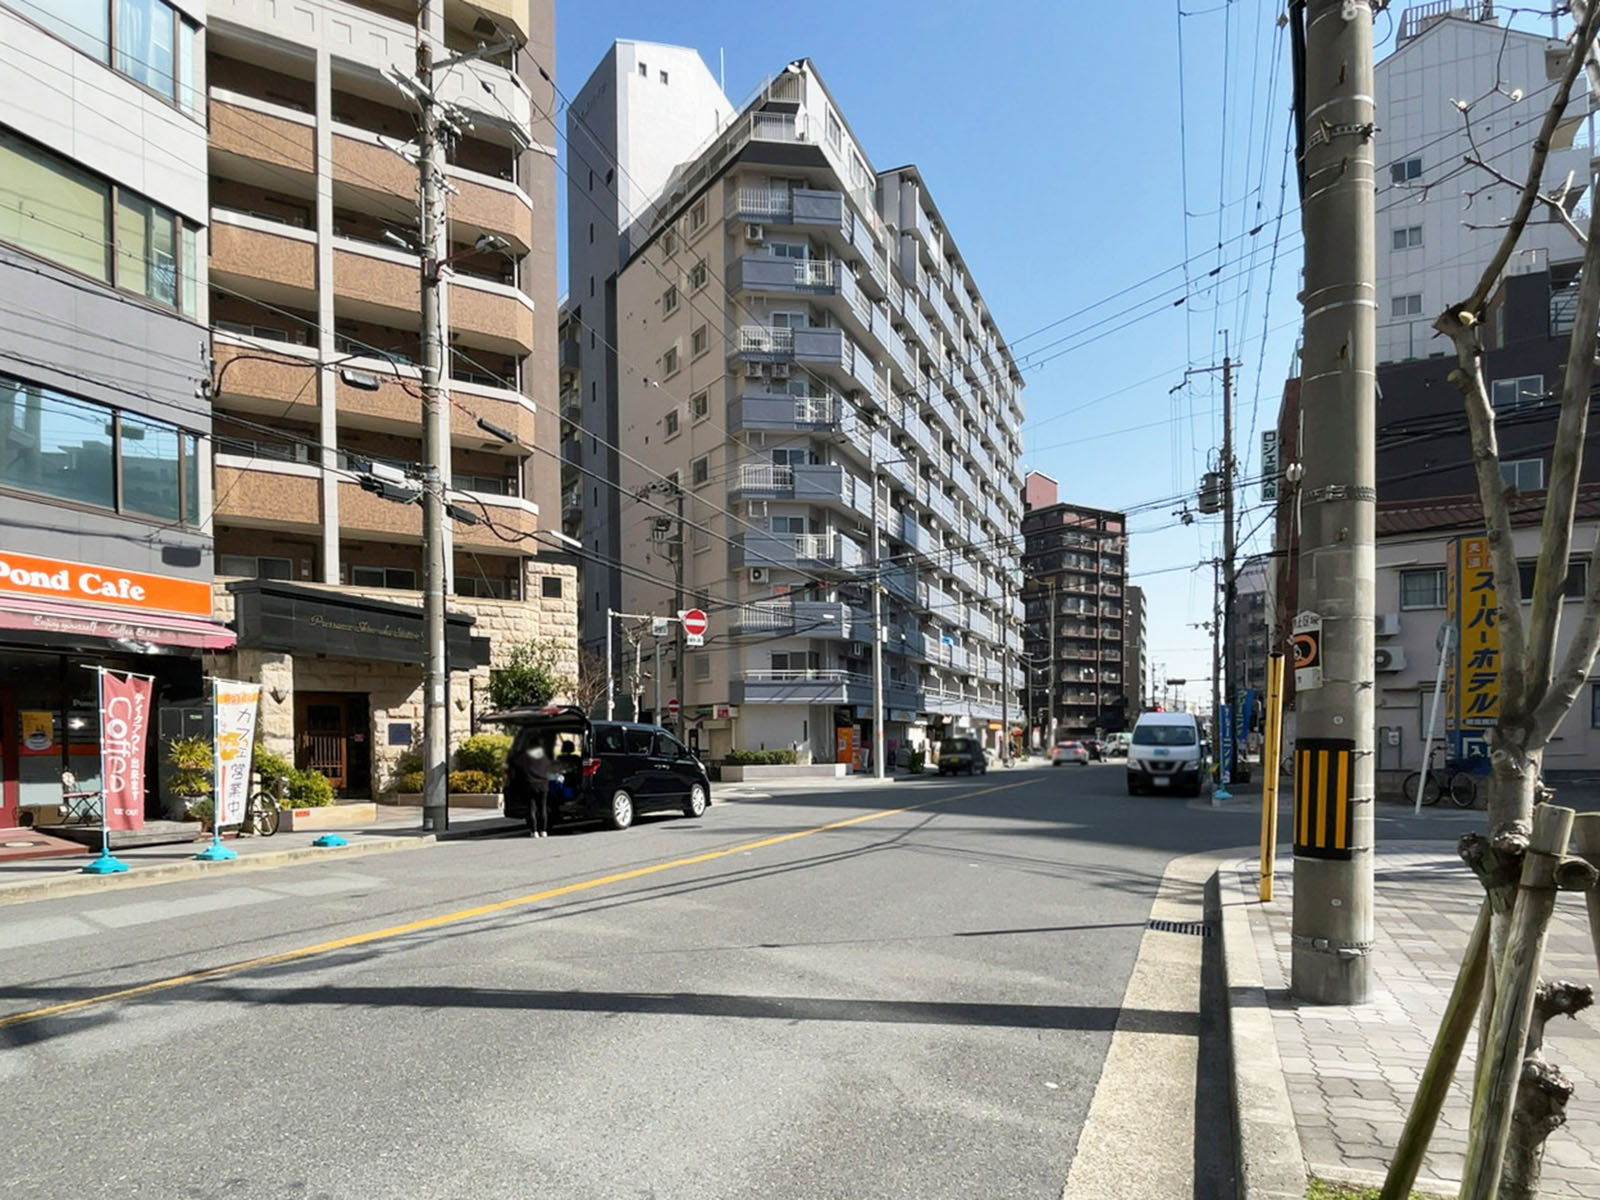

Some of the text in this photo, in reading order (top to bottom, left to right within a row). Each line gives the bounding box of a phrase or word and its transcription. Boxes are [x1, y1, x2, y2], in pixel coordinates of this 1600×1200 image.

[78, 573, 146, 601] Cafe
[60, 620, 98, 635] yourself
[1467, 571, 1499, 713] スーパーホテル
[106, 696, 133, 793] Coffee
[131, 692, 145, 755] テイクアウト
[227, 708, 252, 817] カフェ営業中
